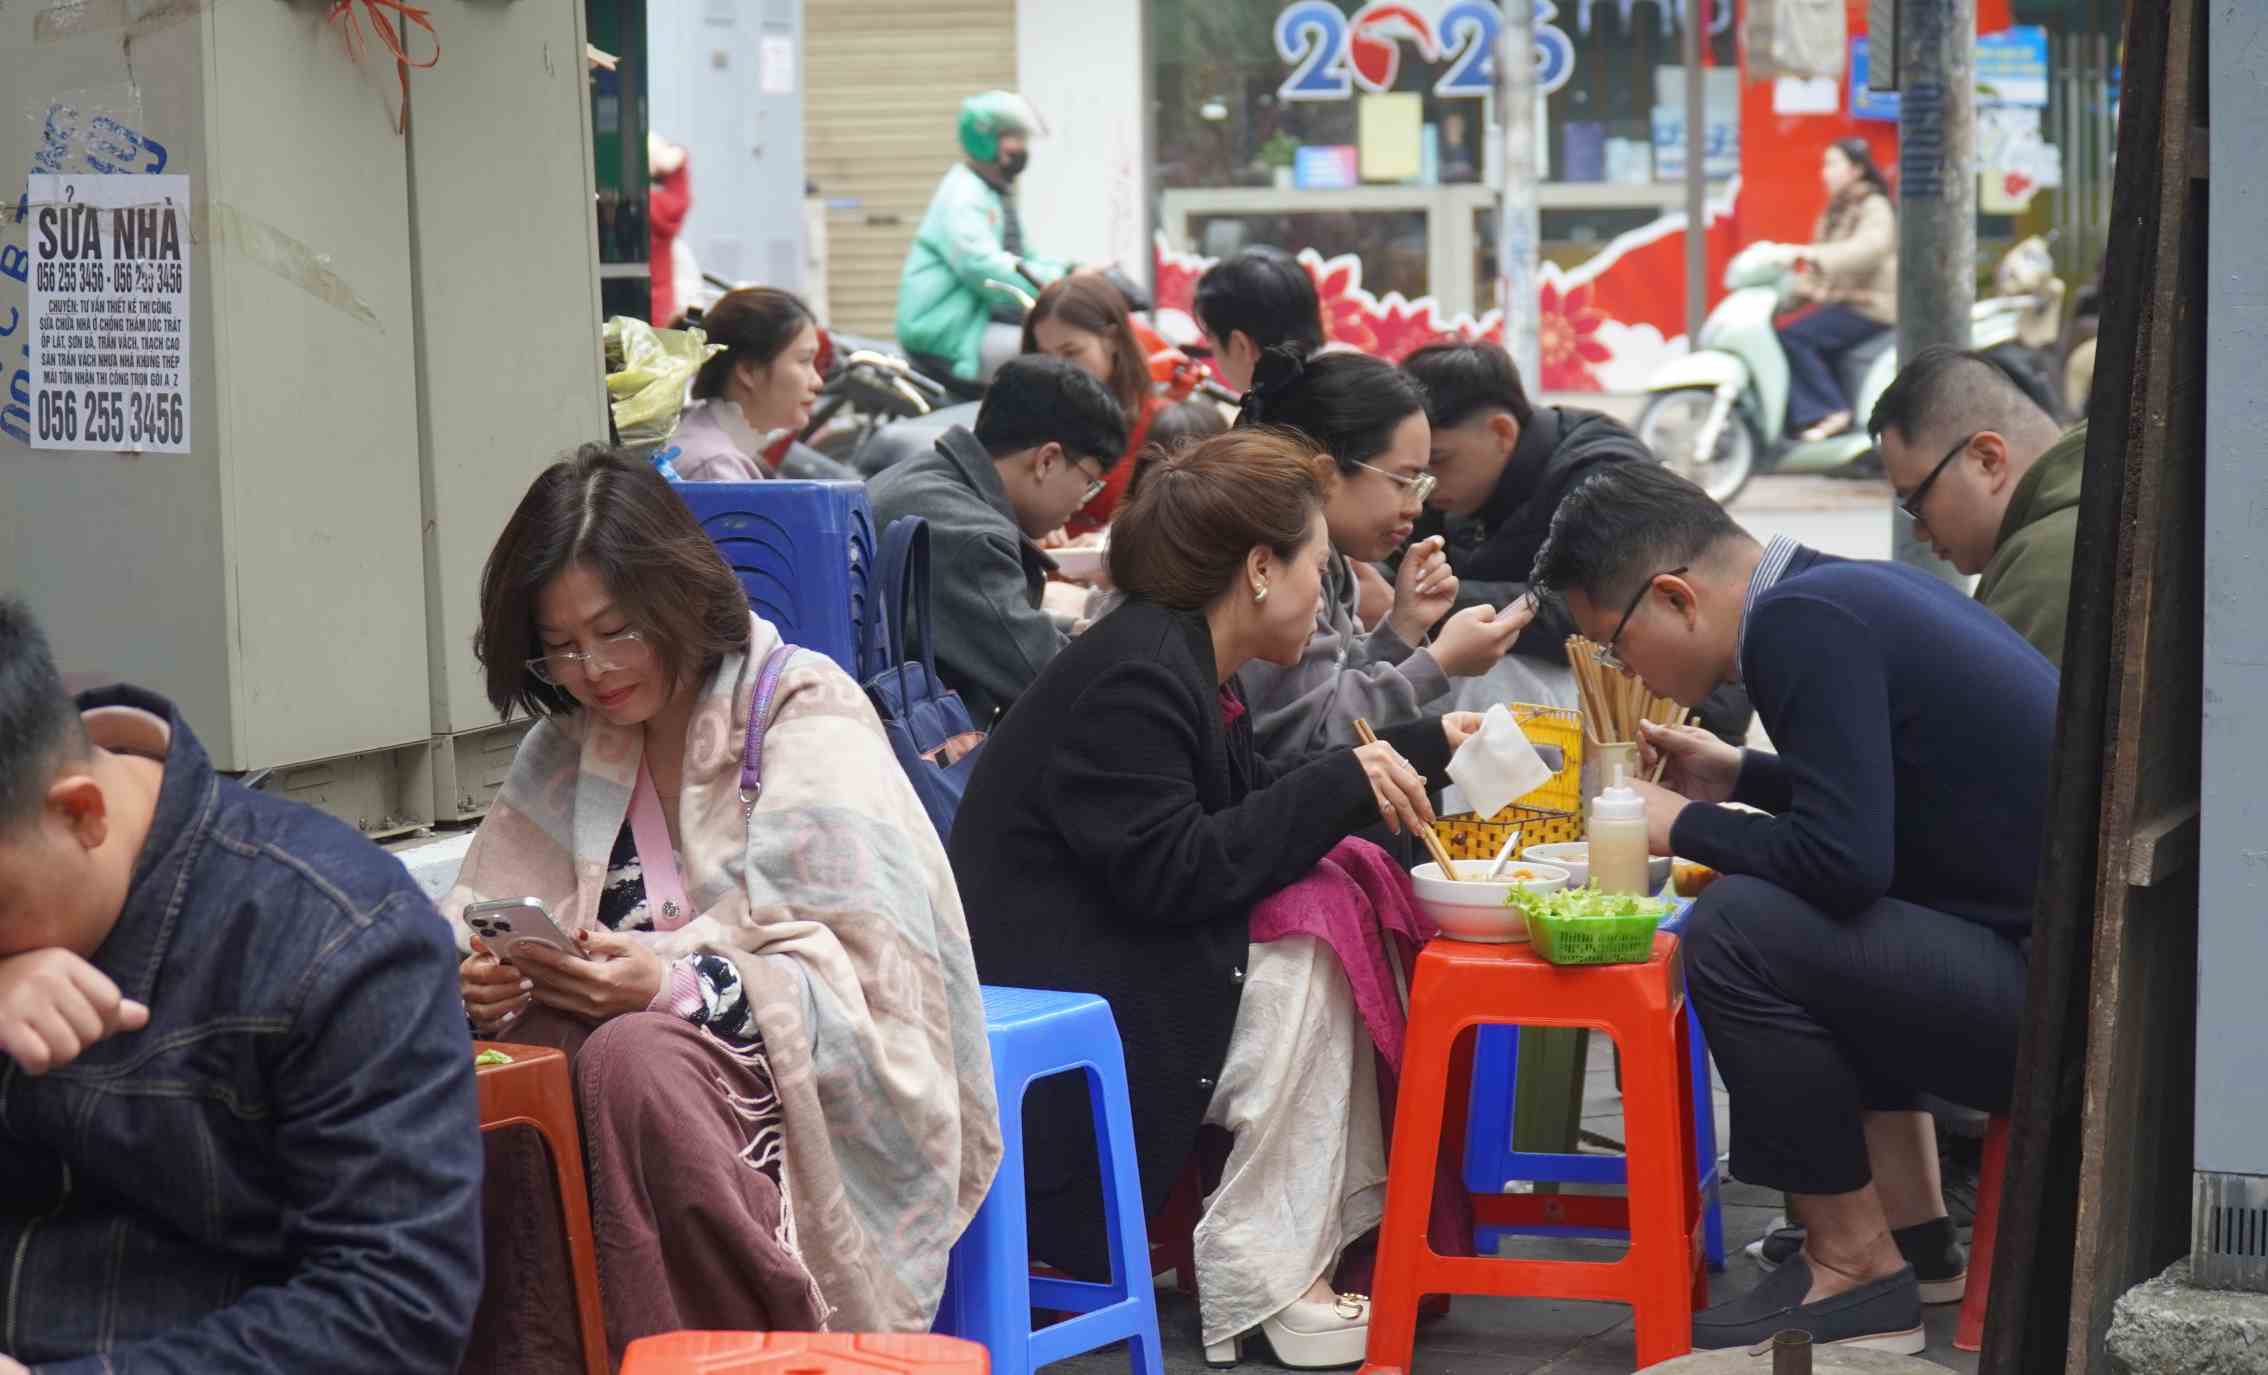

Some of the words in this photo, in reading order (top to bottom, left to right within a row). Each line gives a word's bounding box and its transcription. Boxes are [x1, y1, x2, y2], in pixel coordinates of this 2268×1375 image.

[38, 184, 102, 260] SỬA
[113, 196, 181, 260] NHÀ
[37, 262, 55, 292] 056
[58, 262, 77, 292] 255
[79, 262, 104, 292] 3456
[114, 263, 133, 293] 056
[157, 263, 182, 293] 3456
[139, 300, 150, 313] THI
[166, 337, 180, 350] CAO
[96, 372, 107, 384] THI
[38, 389, 77, 441] 056
[84, 390, 124, 443] 255
[130, 391, 184, 445] 3456
